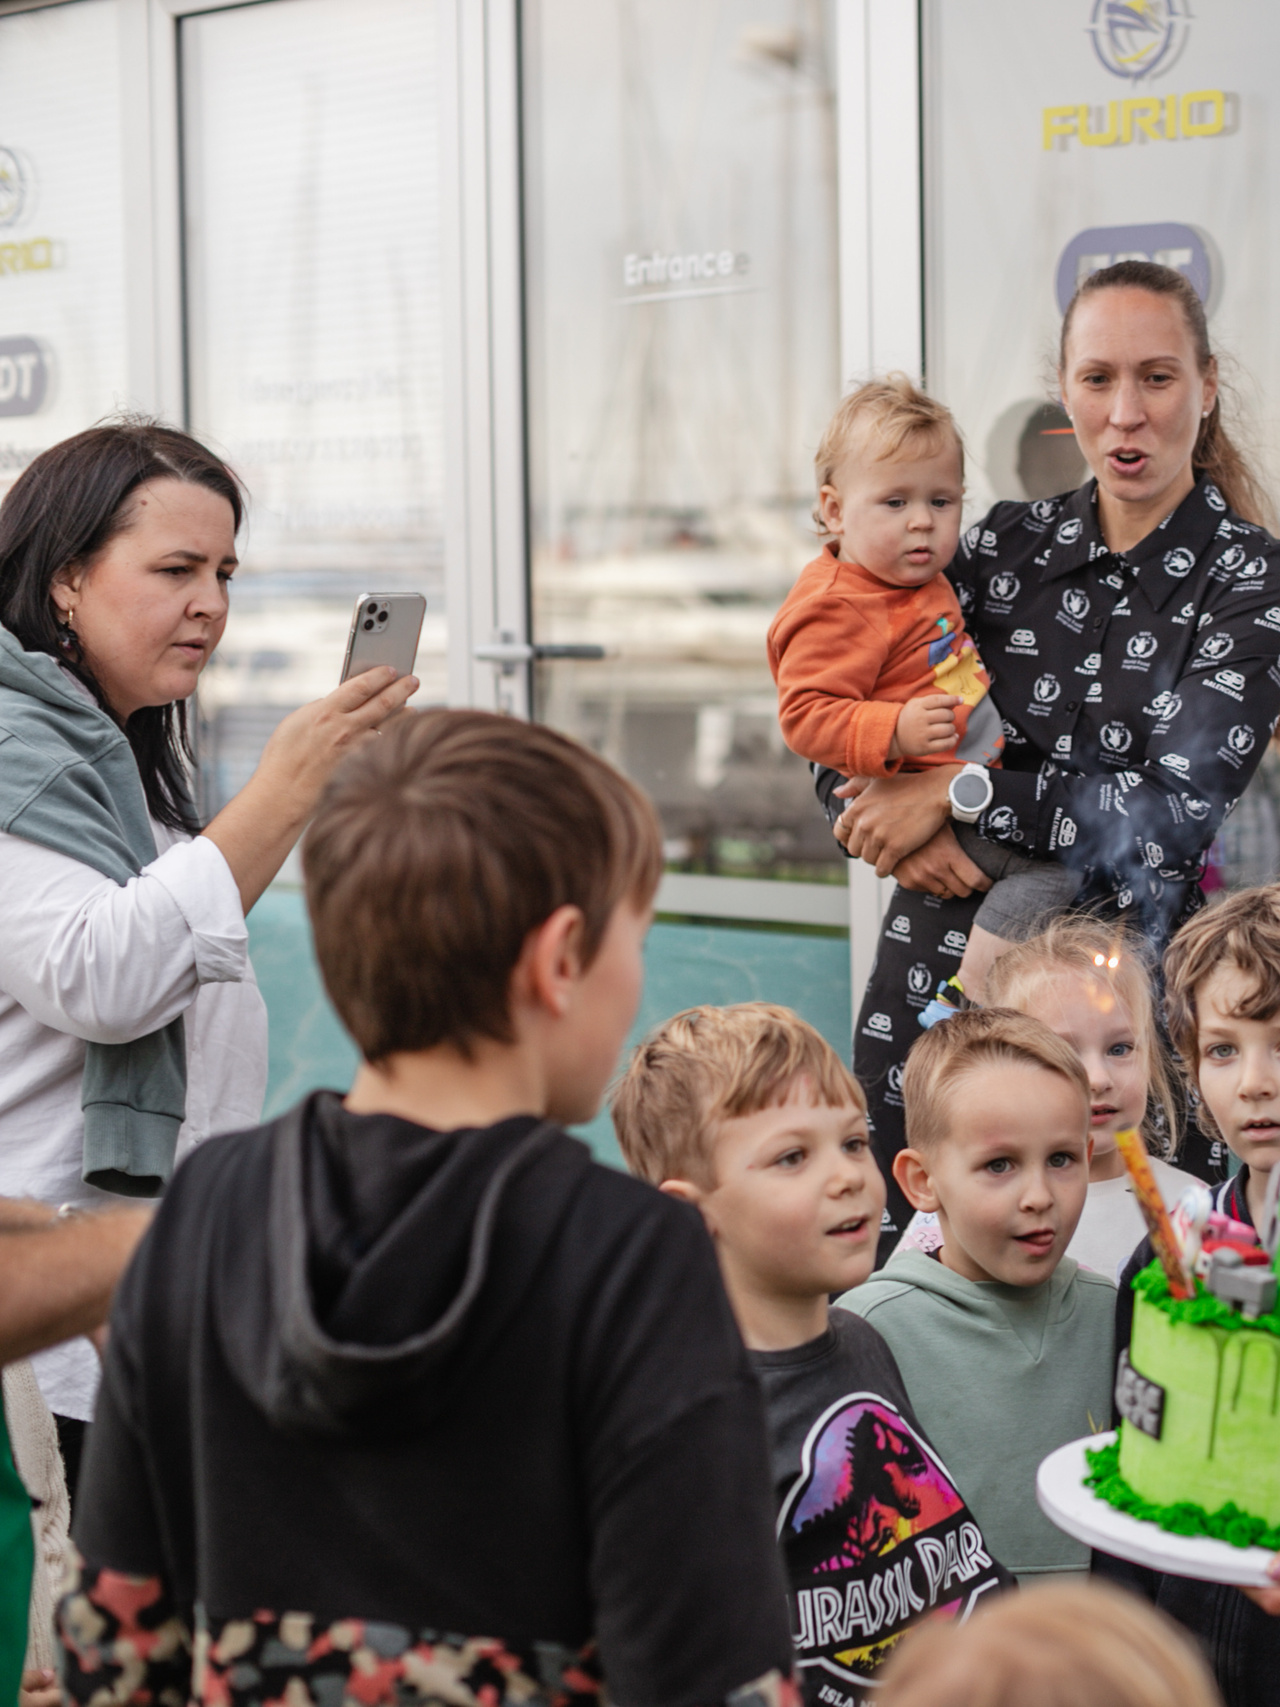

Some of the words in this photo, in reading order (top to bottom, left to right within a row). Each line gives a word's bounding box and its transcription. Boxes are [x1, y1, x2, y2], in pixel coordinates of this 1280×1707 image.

[1041, 88, 1226, 151] FURIO
[623, 249, 735, 287] Entrance
[1202, 678, 1244, 702] BALENCIAGA
[1049, 807, 1063, 851] BALENCIAGA
[792, 1555, 926, 1650] JURASSIC
